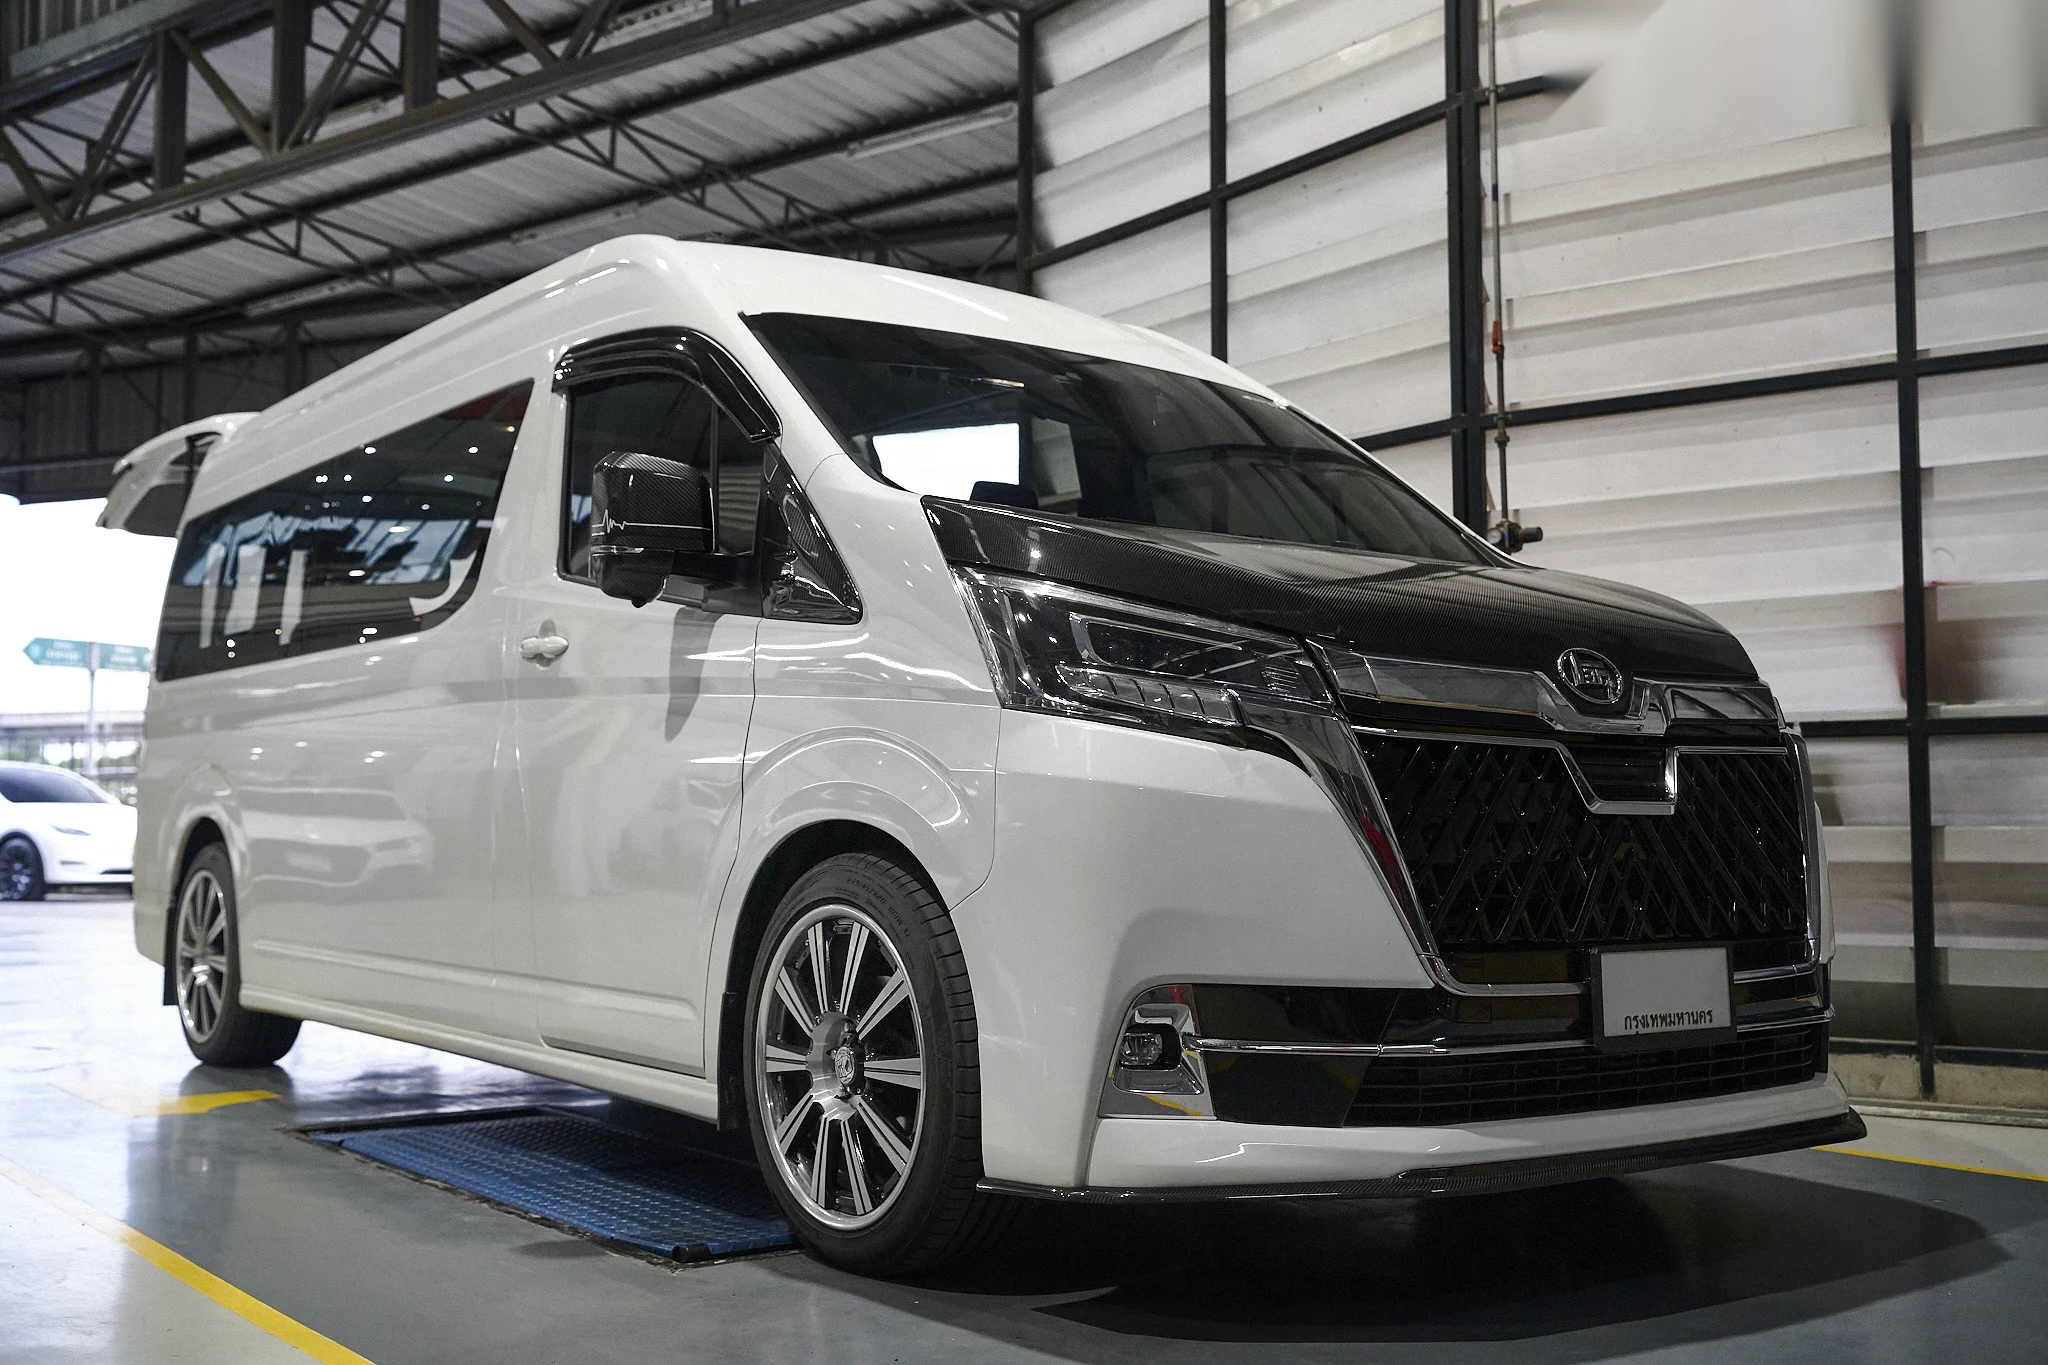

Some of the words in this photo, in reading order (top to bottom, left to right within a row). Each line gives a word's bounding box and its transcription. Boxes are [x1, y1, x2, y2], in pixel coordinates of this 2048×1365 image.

[1624, 1009, 1713, 1035] กรุงเทพมหานคร
